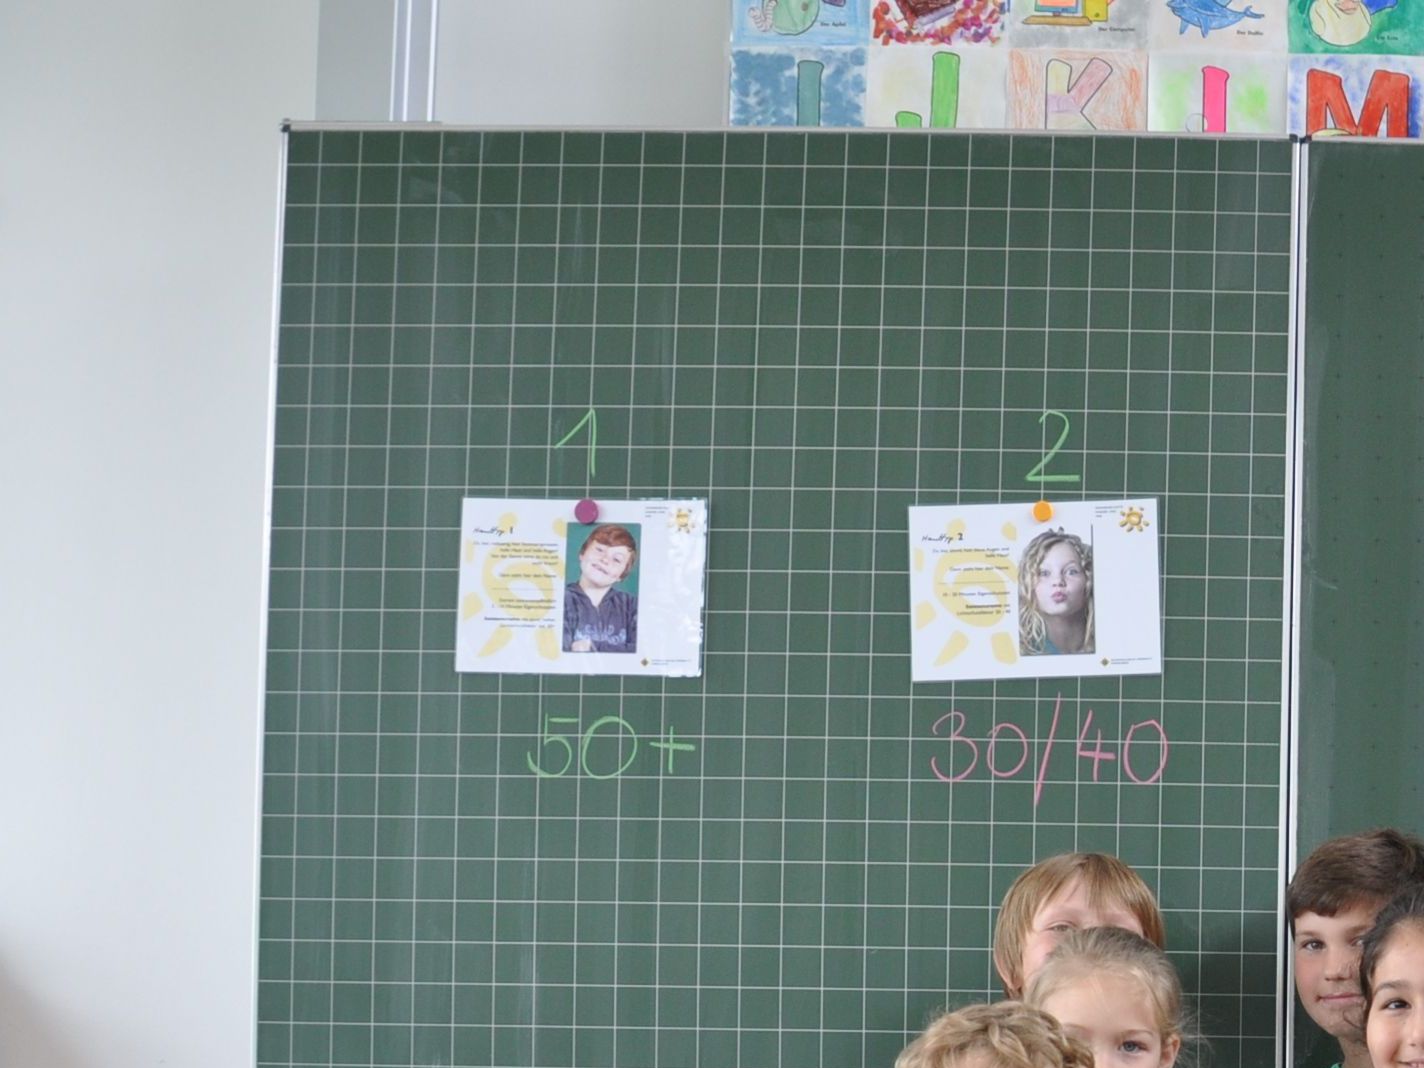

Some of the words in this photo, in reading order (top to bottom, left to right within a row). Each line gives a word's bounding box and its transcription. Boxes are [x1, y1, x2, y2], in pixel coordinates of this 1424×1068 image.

[555, 407, 597, 477] 1
[1025, 409, 1081, 481] 2
[527, 713, 696, 780] 50+
[931, 692, 1168, 807] 30/40
